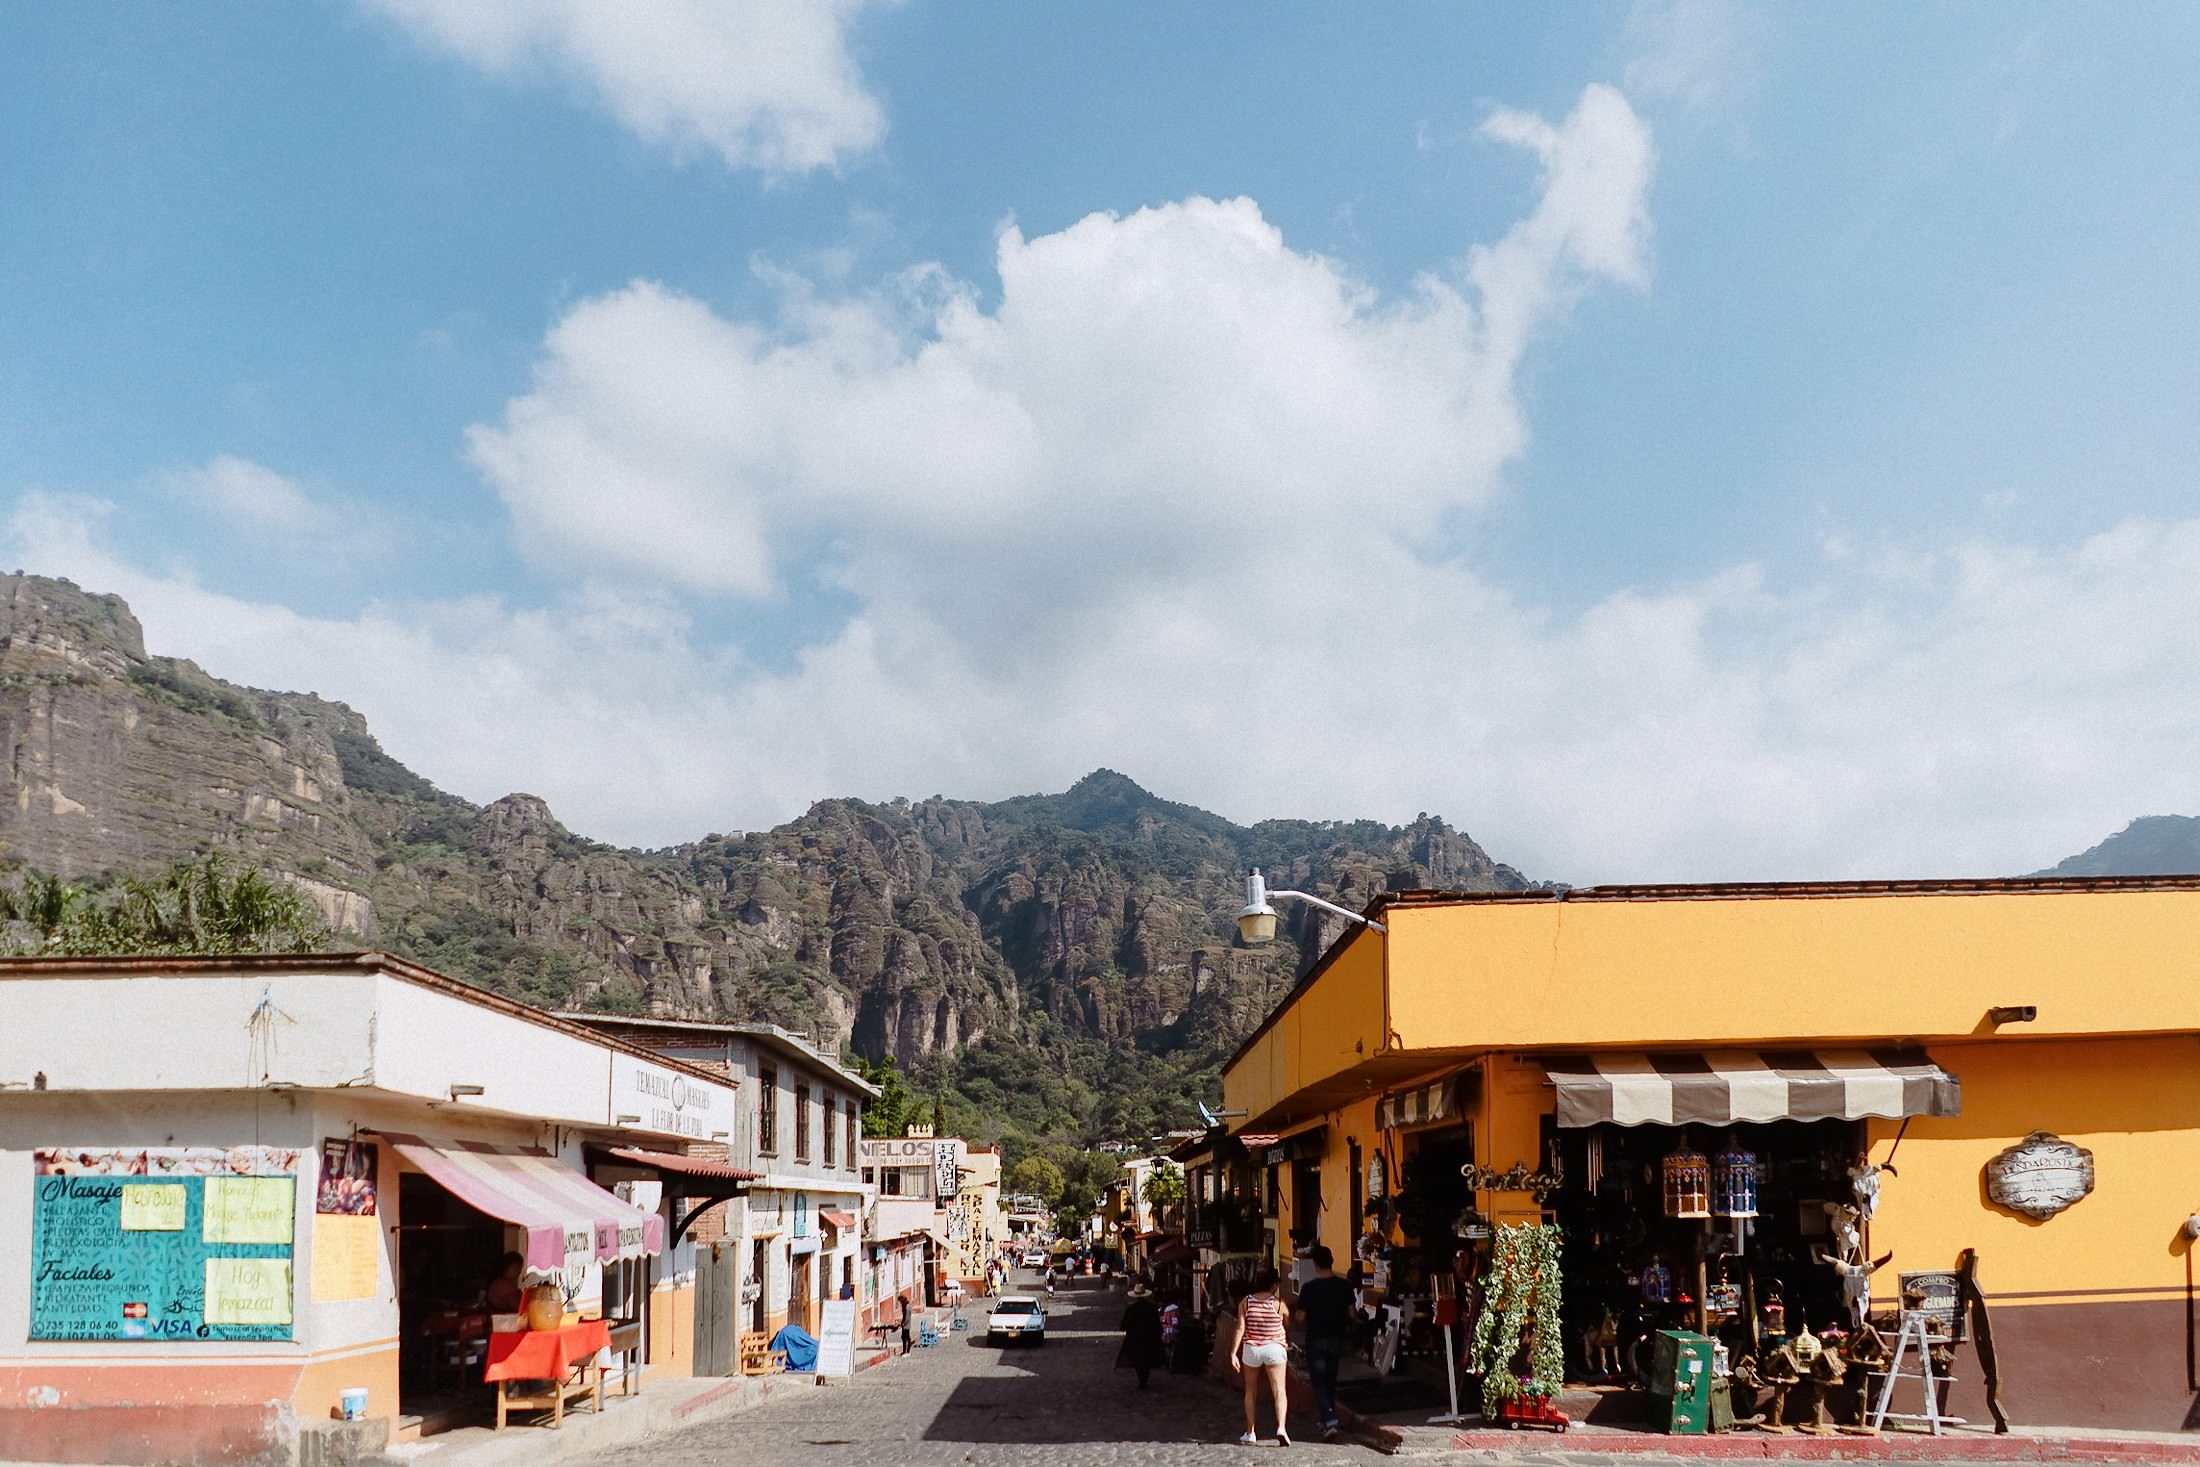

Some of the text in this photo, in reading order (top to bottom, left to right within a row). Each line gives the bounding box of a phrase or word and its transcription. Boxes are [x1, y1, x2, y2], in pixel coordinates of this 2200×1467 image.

[636, 1070, 670, 1100] TEMAZCAL
[1190, 1231, 1213, 1241] PIZZAS
[972, 1220, 982, 1277] TEMAZCAL
[36, 1260, 116, 1281] Faciales
[232, 1265, 261, 1288] Hoy
[45, 1321, 64, 1330] 735
[68, 1321, 86, 1330] 128
[105, 1321, 119, 1330] 40
[152, 1319, 192, 1333] VISA
